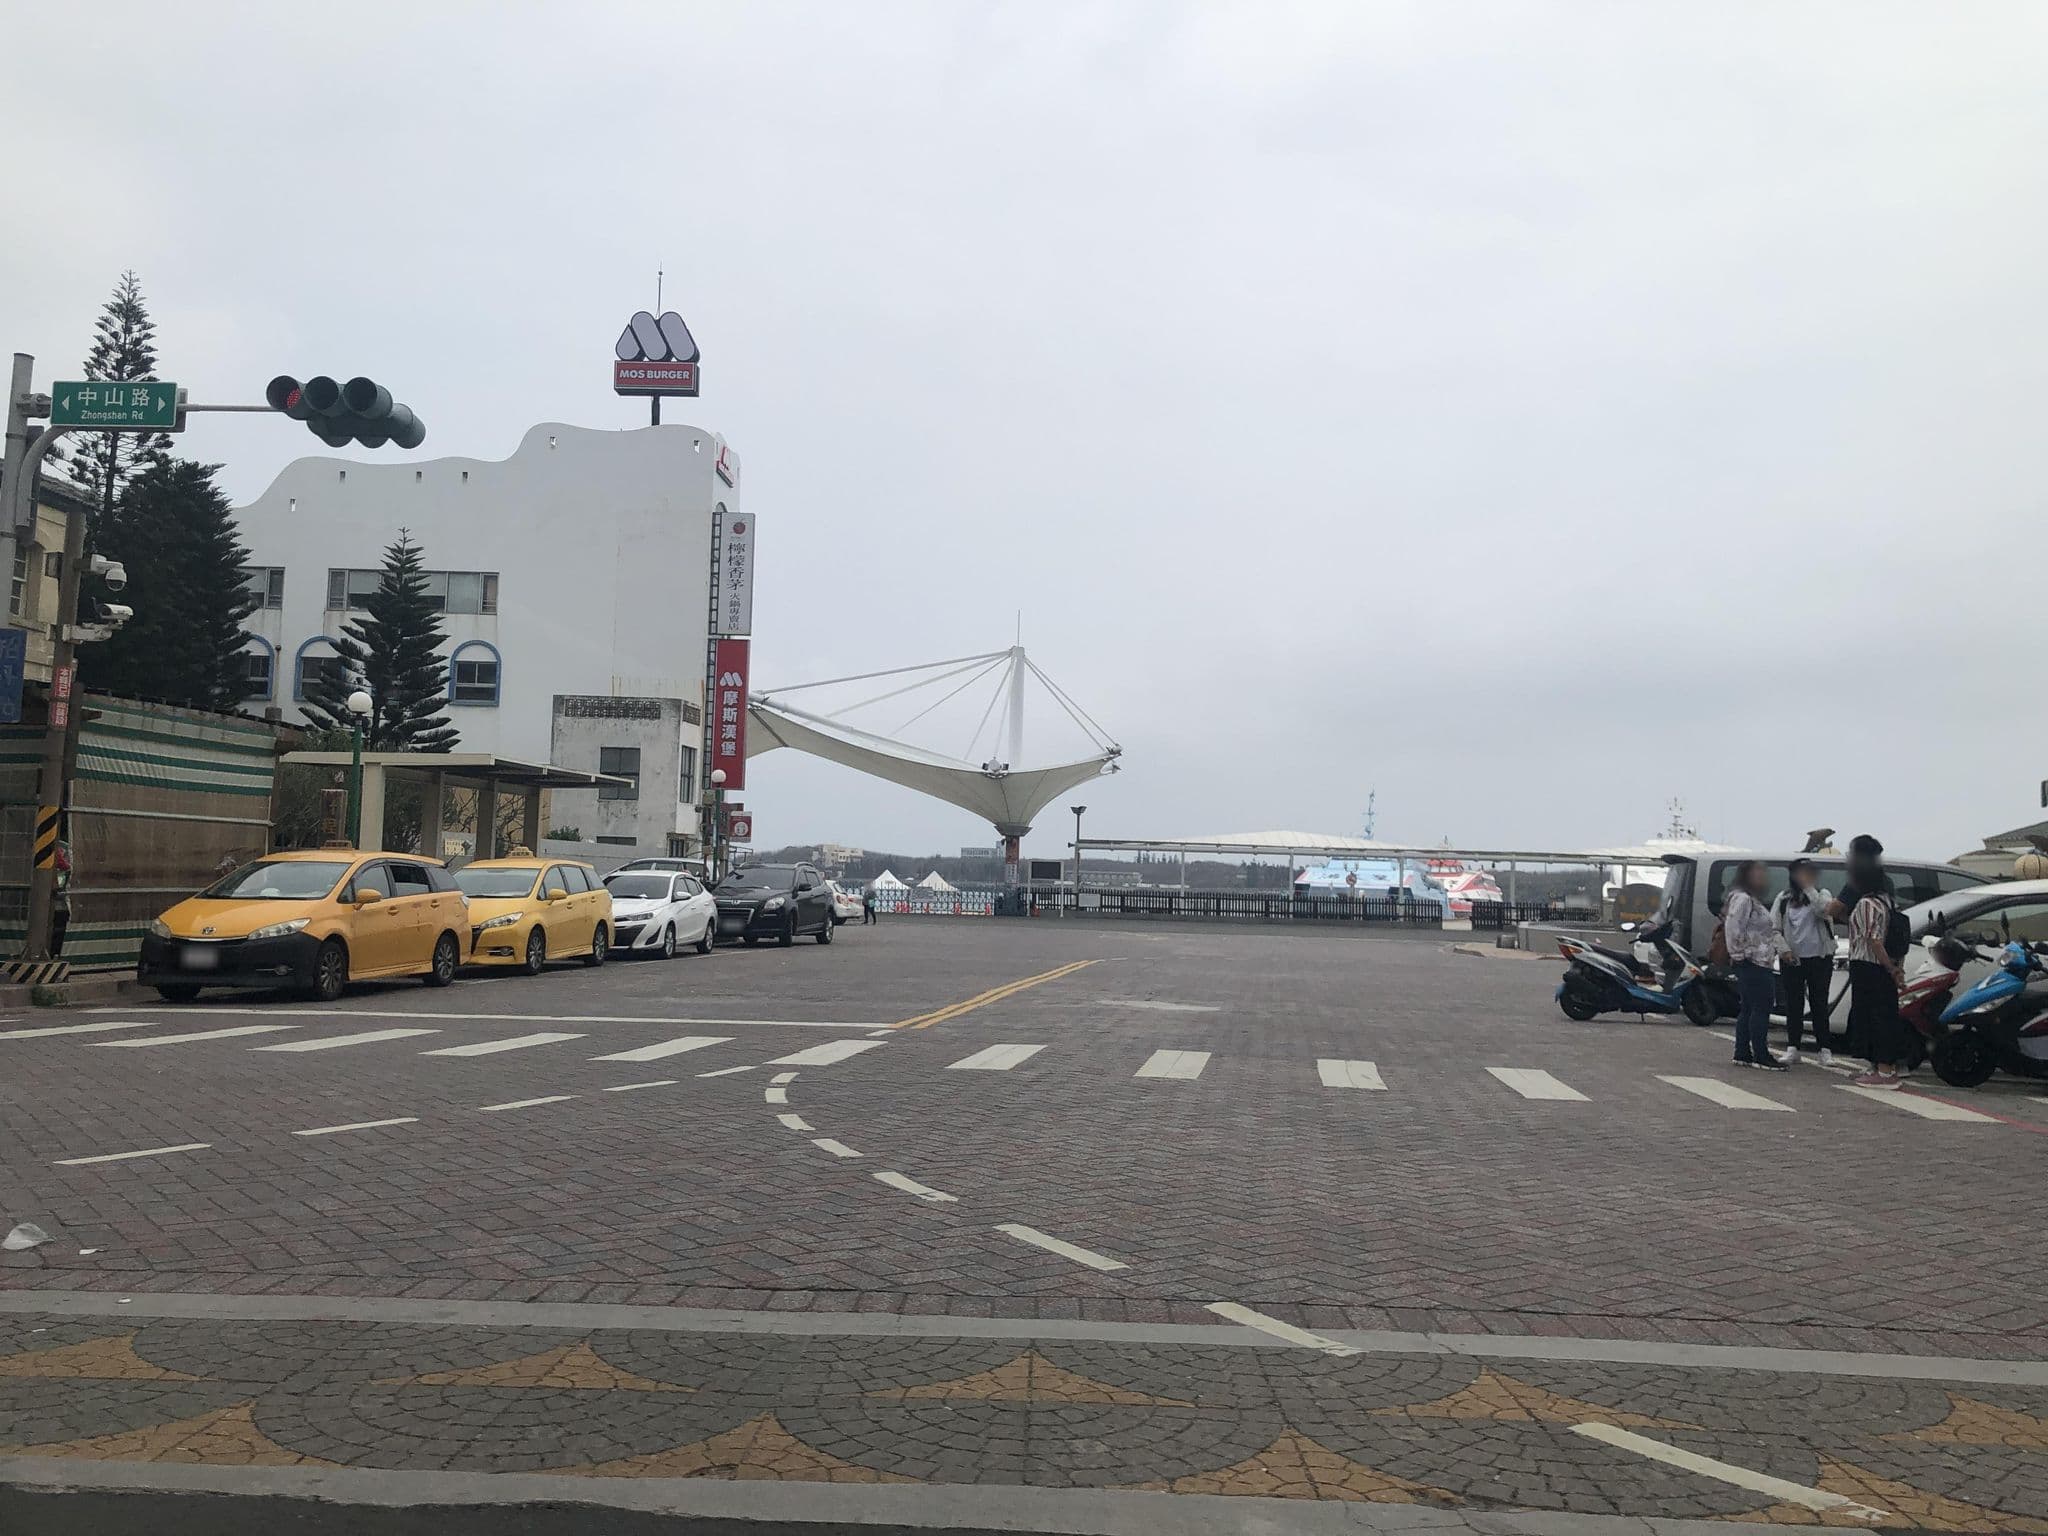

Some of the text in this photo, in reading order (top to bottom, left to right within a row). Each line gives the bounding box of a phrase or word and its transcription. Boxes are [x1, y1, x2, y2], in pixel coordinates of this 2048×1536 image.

[619, 369, 690, 380] MOS BURGER
[78, 387, 151, 407] 中山路
[81, 410, 144, 421] Zhongshan Rd
[721, 690, 739, 756] 摩斯漢堡
